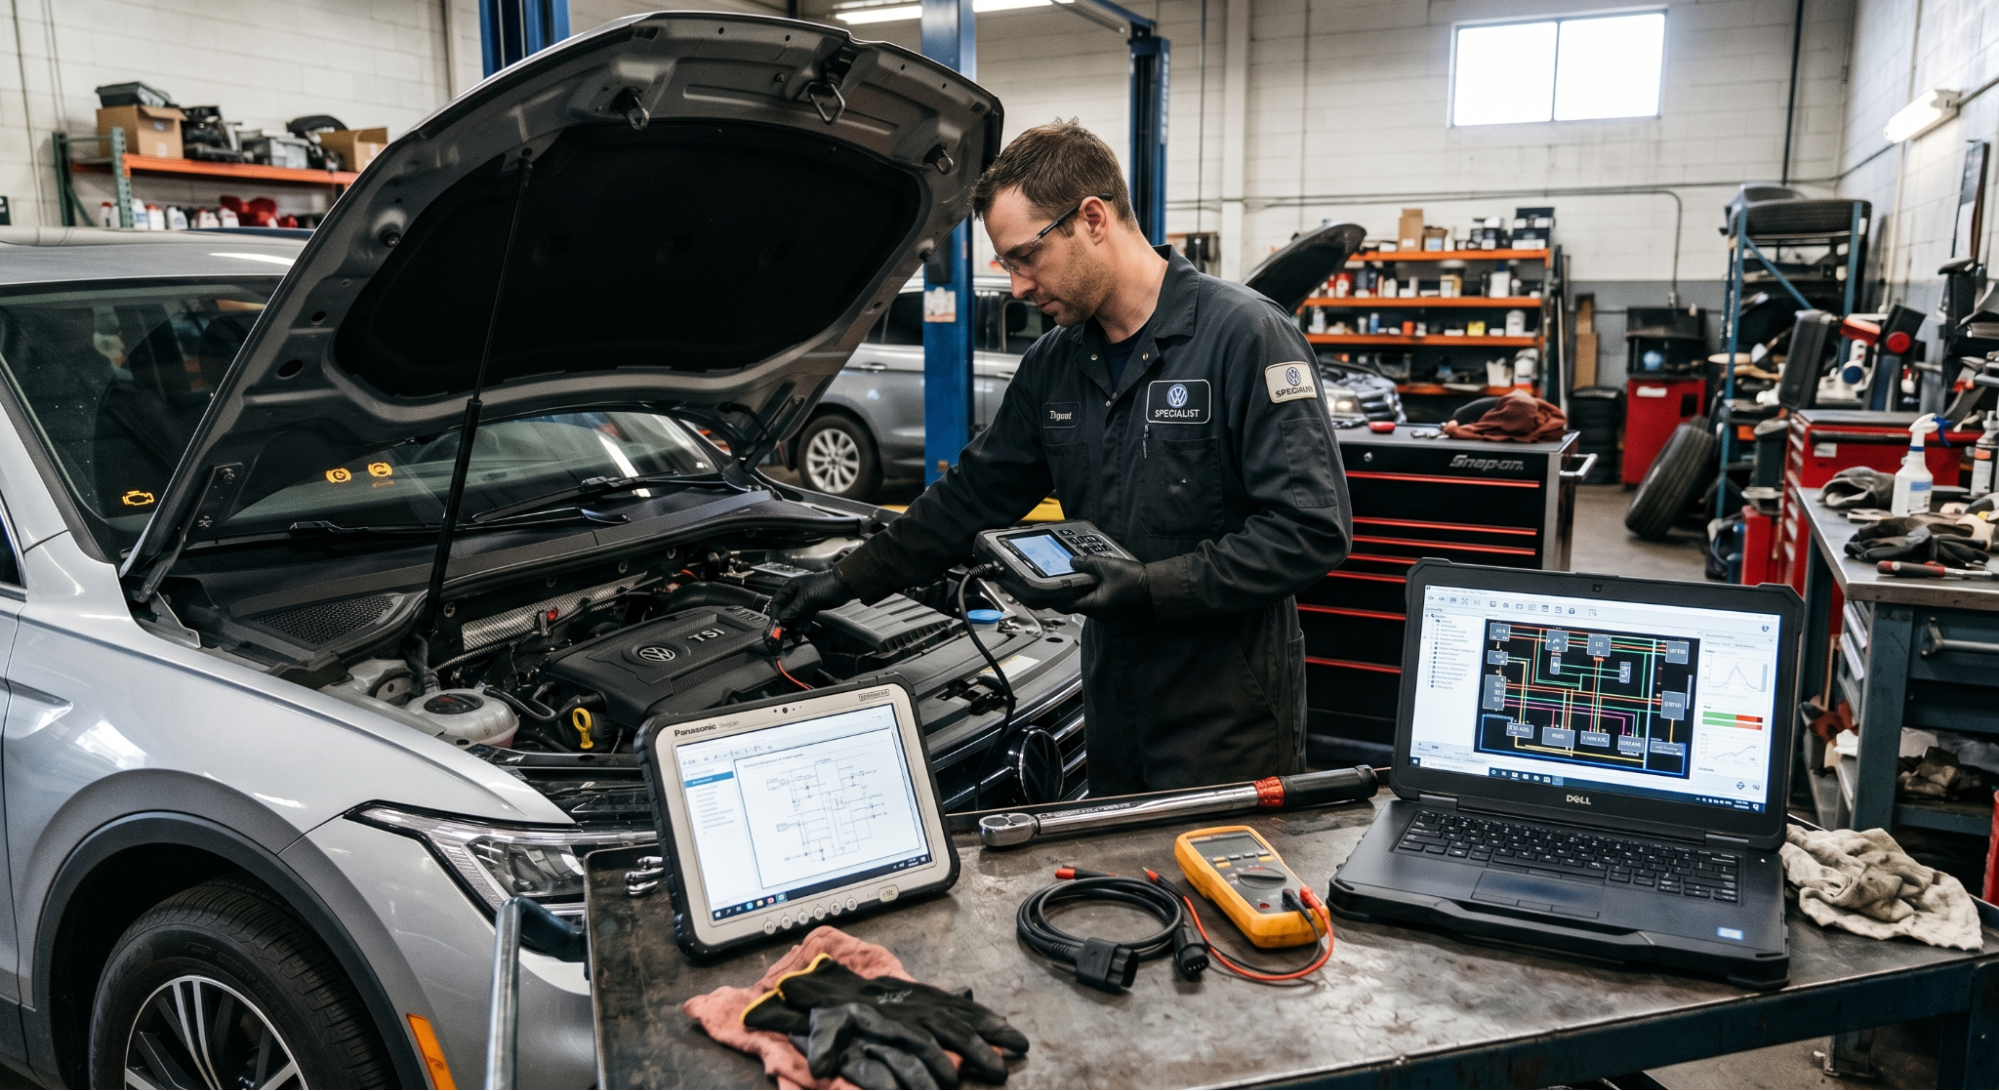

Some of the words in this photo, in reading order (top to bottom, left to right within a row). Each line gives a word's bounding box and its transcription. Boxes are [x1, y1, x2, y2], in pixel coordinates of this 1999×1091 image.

[1154, 408, 1200, 418] SPECIALIST
[1449, 454, 1524, 472] Snap-on
[687, 628, 725, 643] TSI
[674, 722, 717, 738] Panasonic
[1566, 794, 1592, 806] DELL
